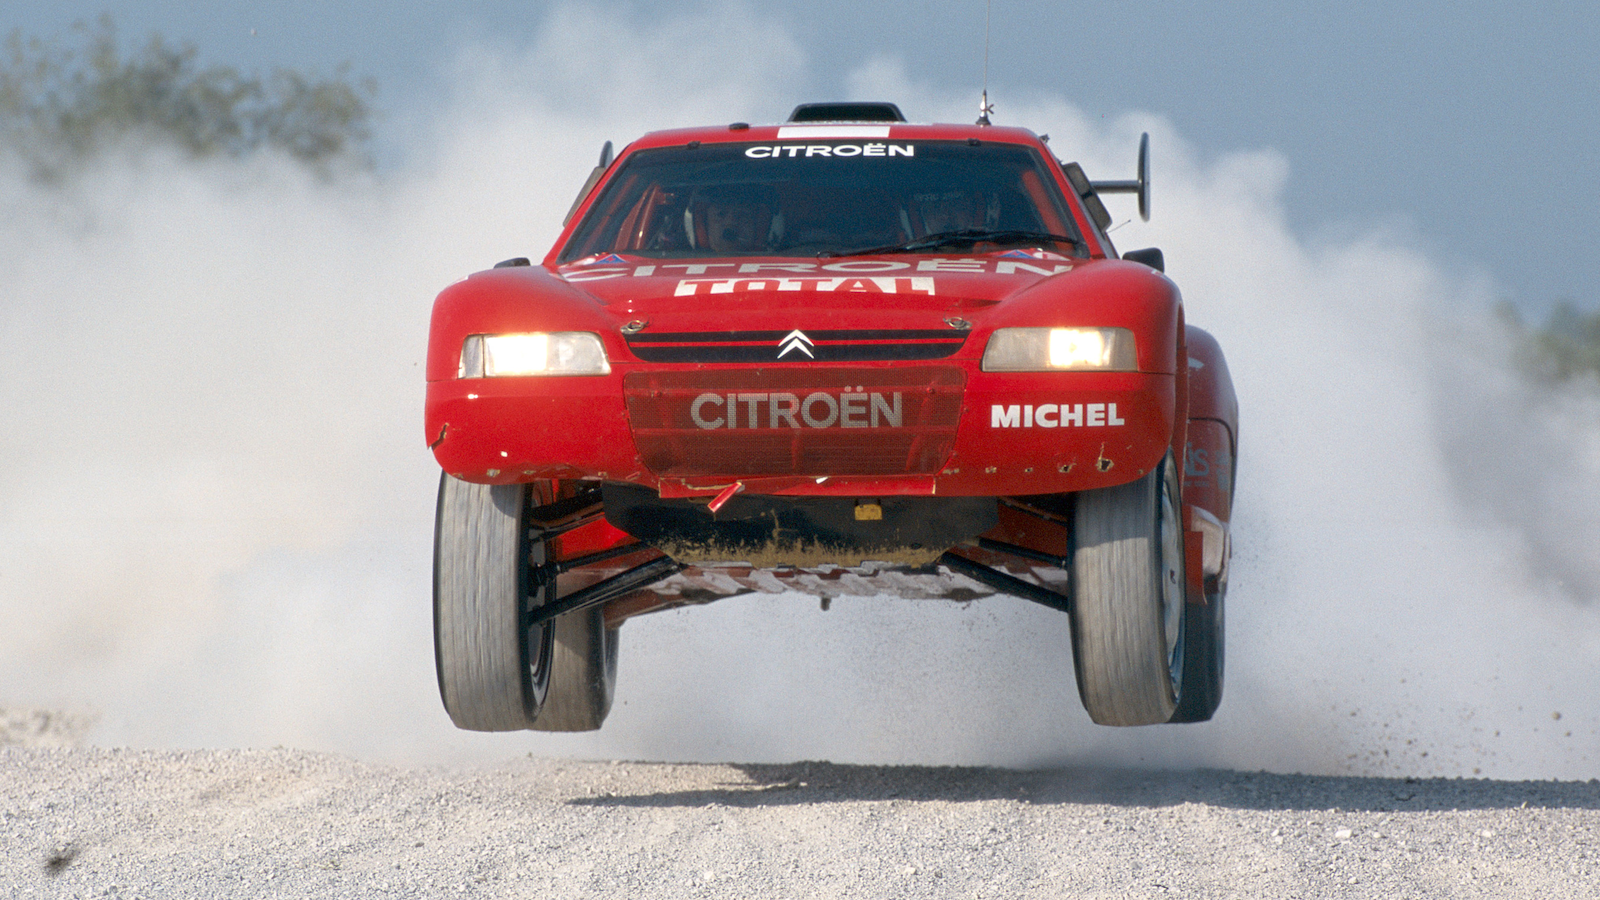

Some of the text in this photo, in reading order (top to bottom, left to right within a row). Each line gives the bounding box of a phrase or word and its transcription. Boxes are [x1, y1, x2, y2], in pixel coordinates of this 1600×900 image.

[745, 143, 914, 158] CITROËN
[561, 258, 1074, 282] CITROËN
[678, 277, 933, 296] TOTAL
[690, 385, 903, 430] CITROËN
[991, 403, 1125, 428] MICHEL
